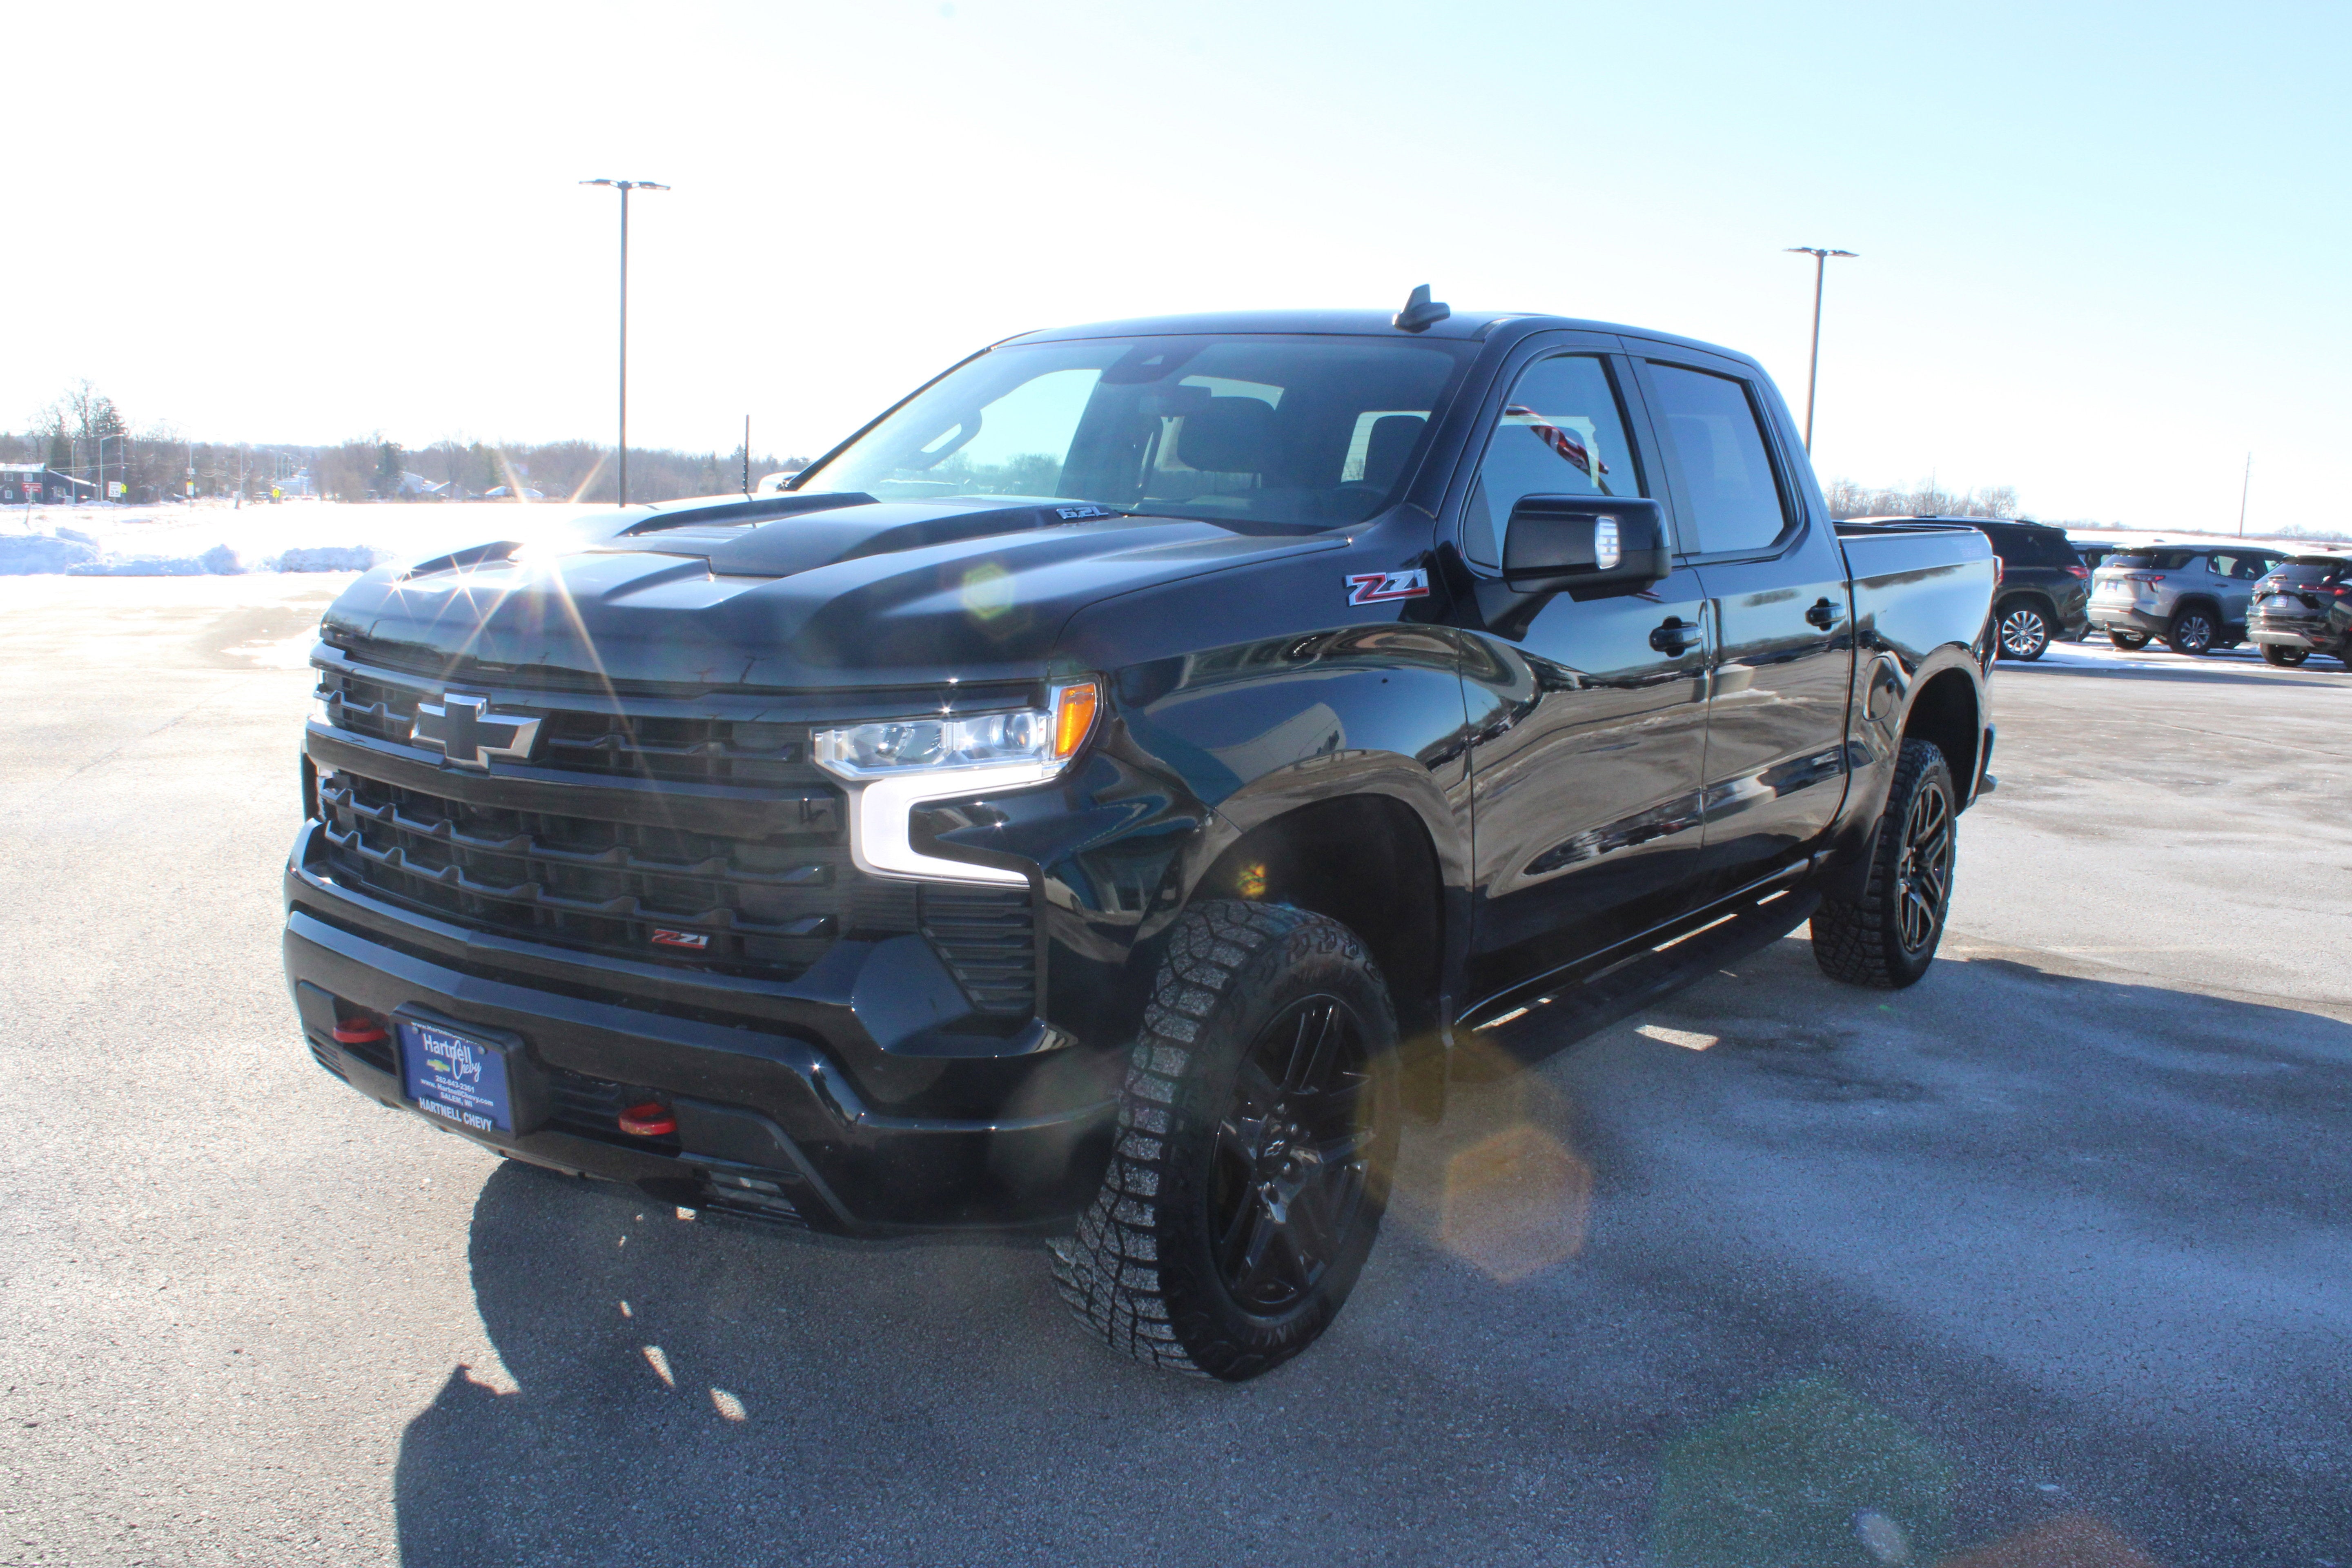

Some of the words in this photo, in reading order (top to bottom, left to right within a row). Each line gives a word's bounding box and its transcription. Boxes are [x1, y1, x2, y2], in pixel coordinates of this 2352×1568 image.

[1345, 568, 1429, 606] Z71
[652, 929, 709, 949] Z71
[423, 1033, 472, 1062] Hartnell
[453, 1040, 481, 1082] Chevy
[419, 1097, 462, 1122] HARTNELL
[463, 1112, 492, 1132] CHEVY
[441, 1092, 463, 1106] SALEM,
[464, 1099, 473, 1107] WI
